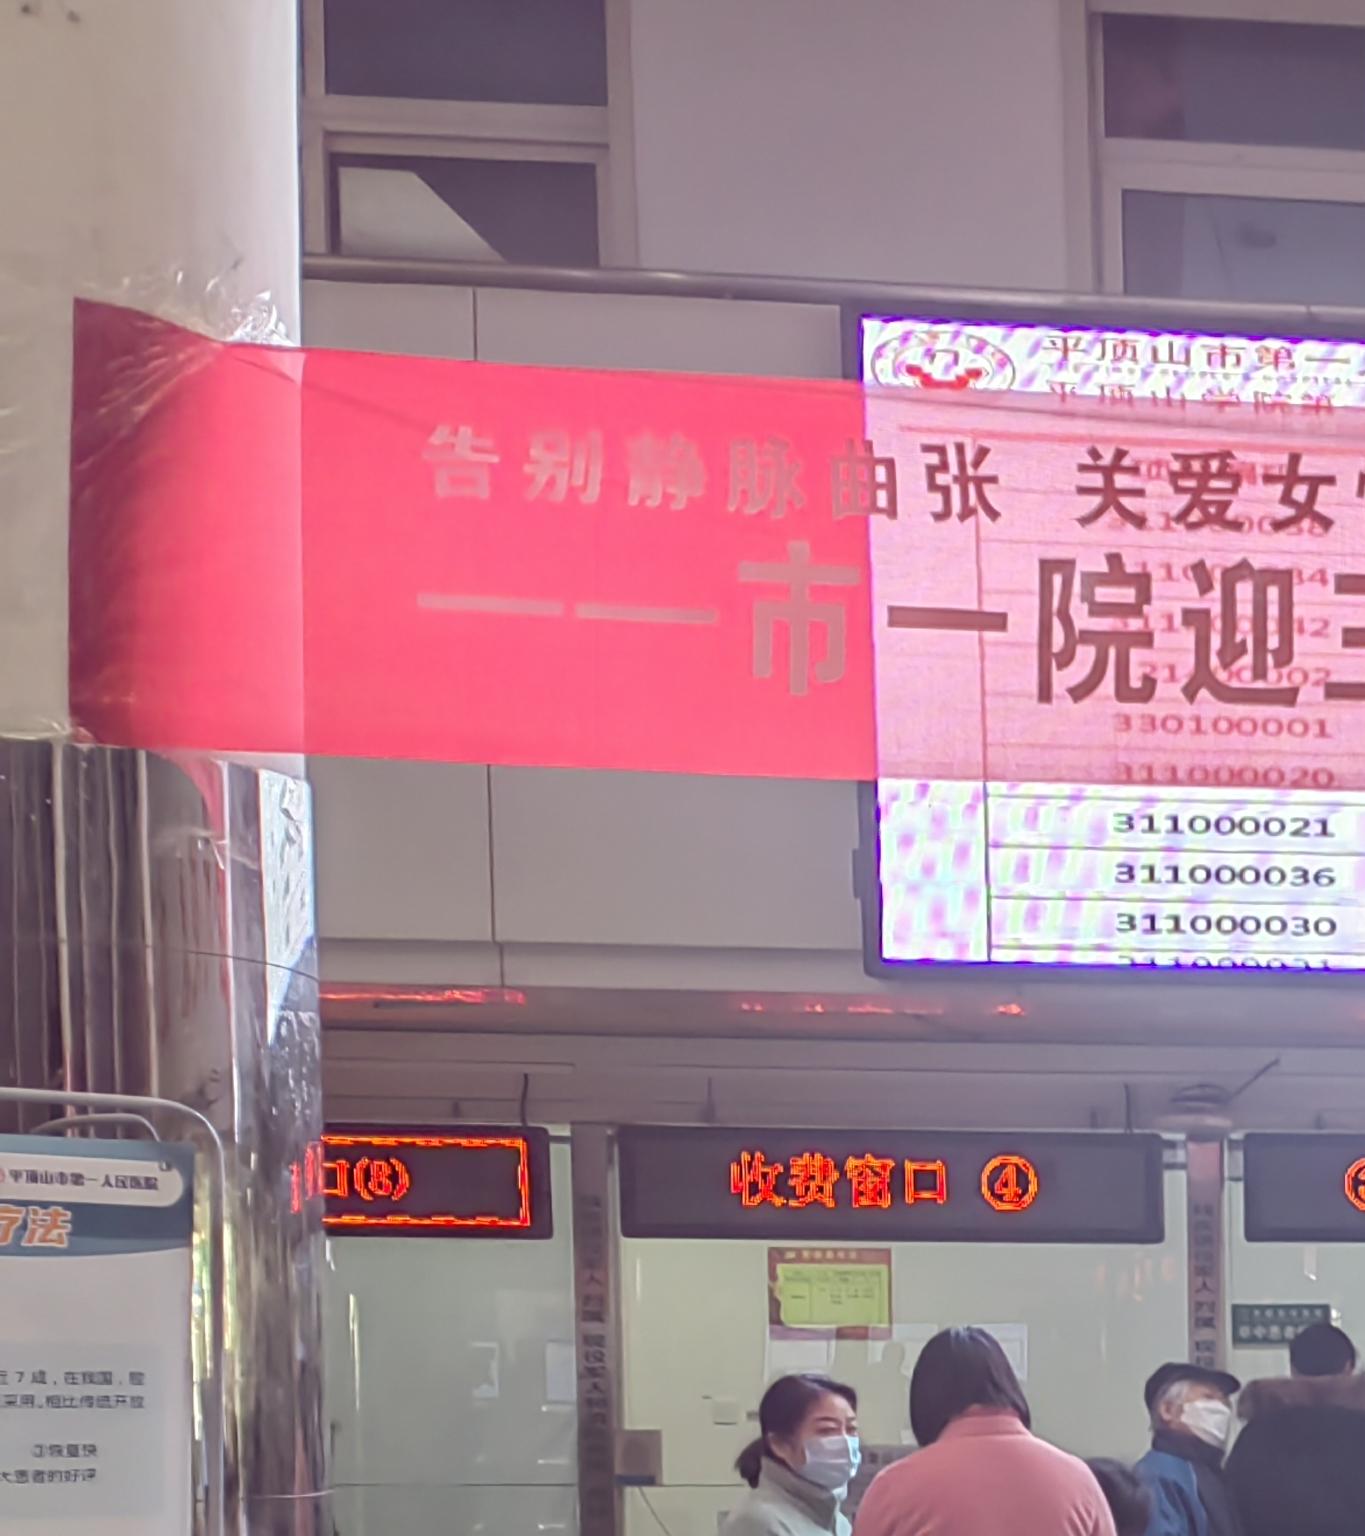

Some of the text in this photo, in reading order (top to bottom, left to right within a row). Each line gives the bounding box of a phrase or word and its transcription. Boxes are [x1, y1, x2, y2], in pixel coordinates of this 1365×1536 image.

[421, 425, 1002, 523] 告别静脉曲张
[1113, 713, 1332, 738] 330100001
[1112, 812, 1336, 838] 311000021
[1114, 862, 1337, 888] 311000036
[1115, 912, 1338, 937] 311000030
[729, 1149, 949, 1209] 收费窗口
